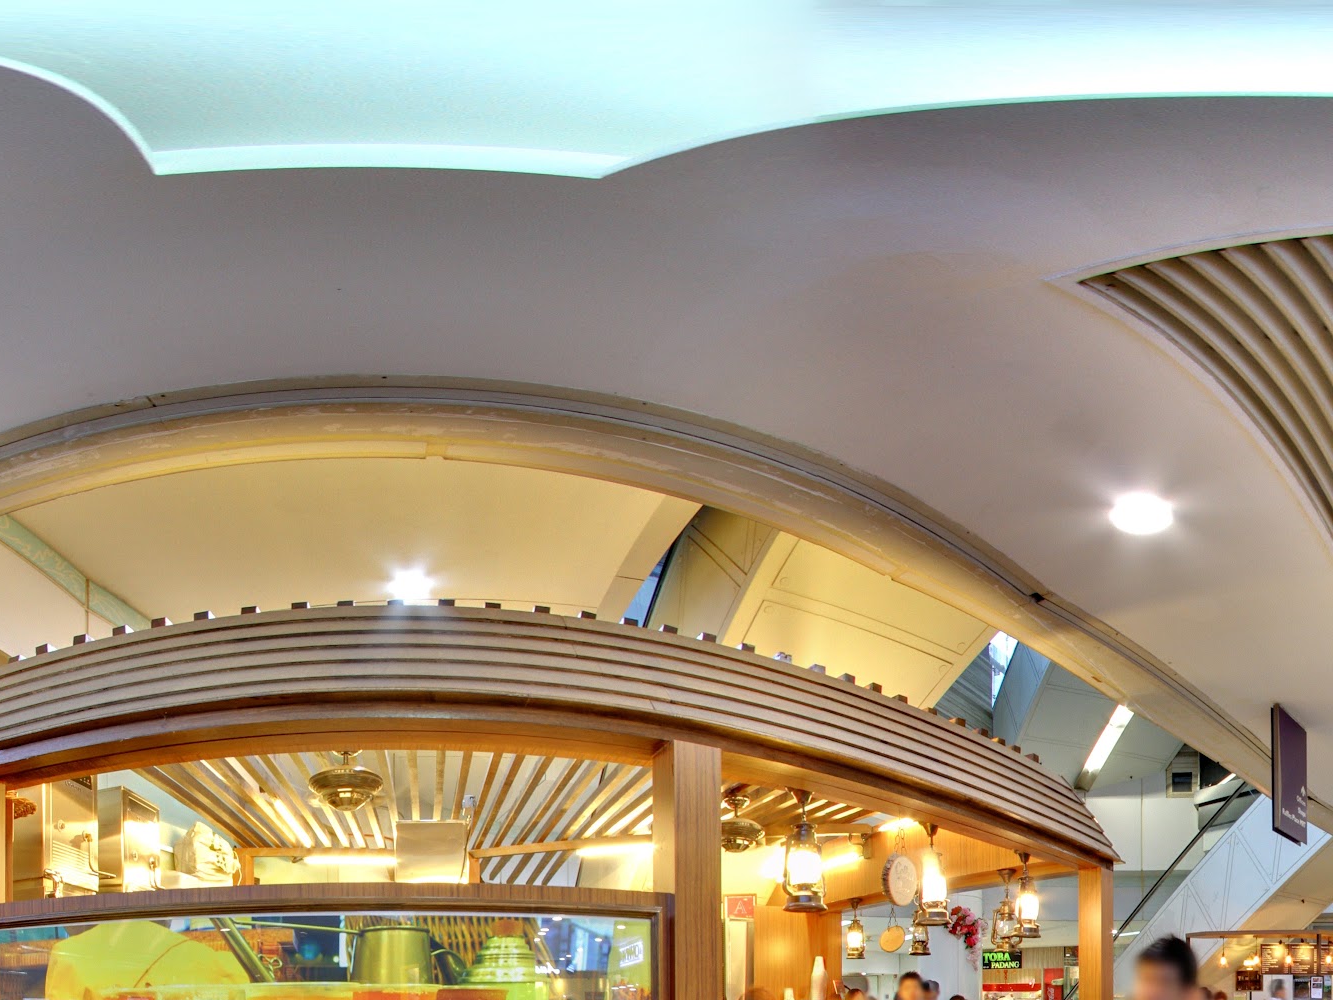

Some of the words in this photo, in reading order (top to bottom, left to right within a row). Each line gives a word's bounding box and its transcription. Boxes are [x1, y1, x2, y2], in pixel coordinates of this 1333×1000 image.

[733, 900, 747, 914] A
[982, 952, 1011, 964] TOBA
[990, 960, 1020, 969] PADANG
